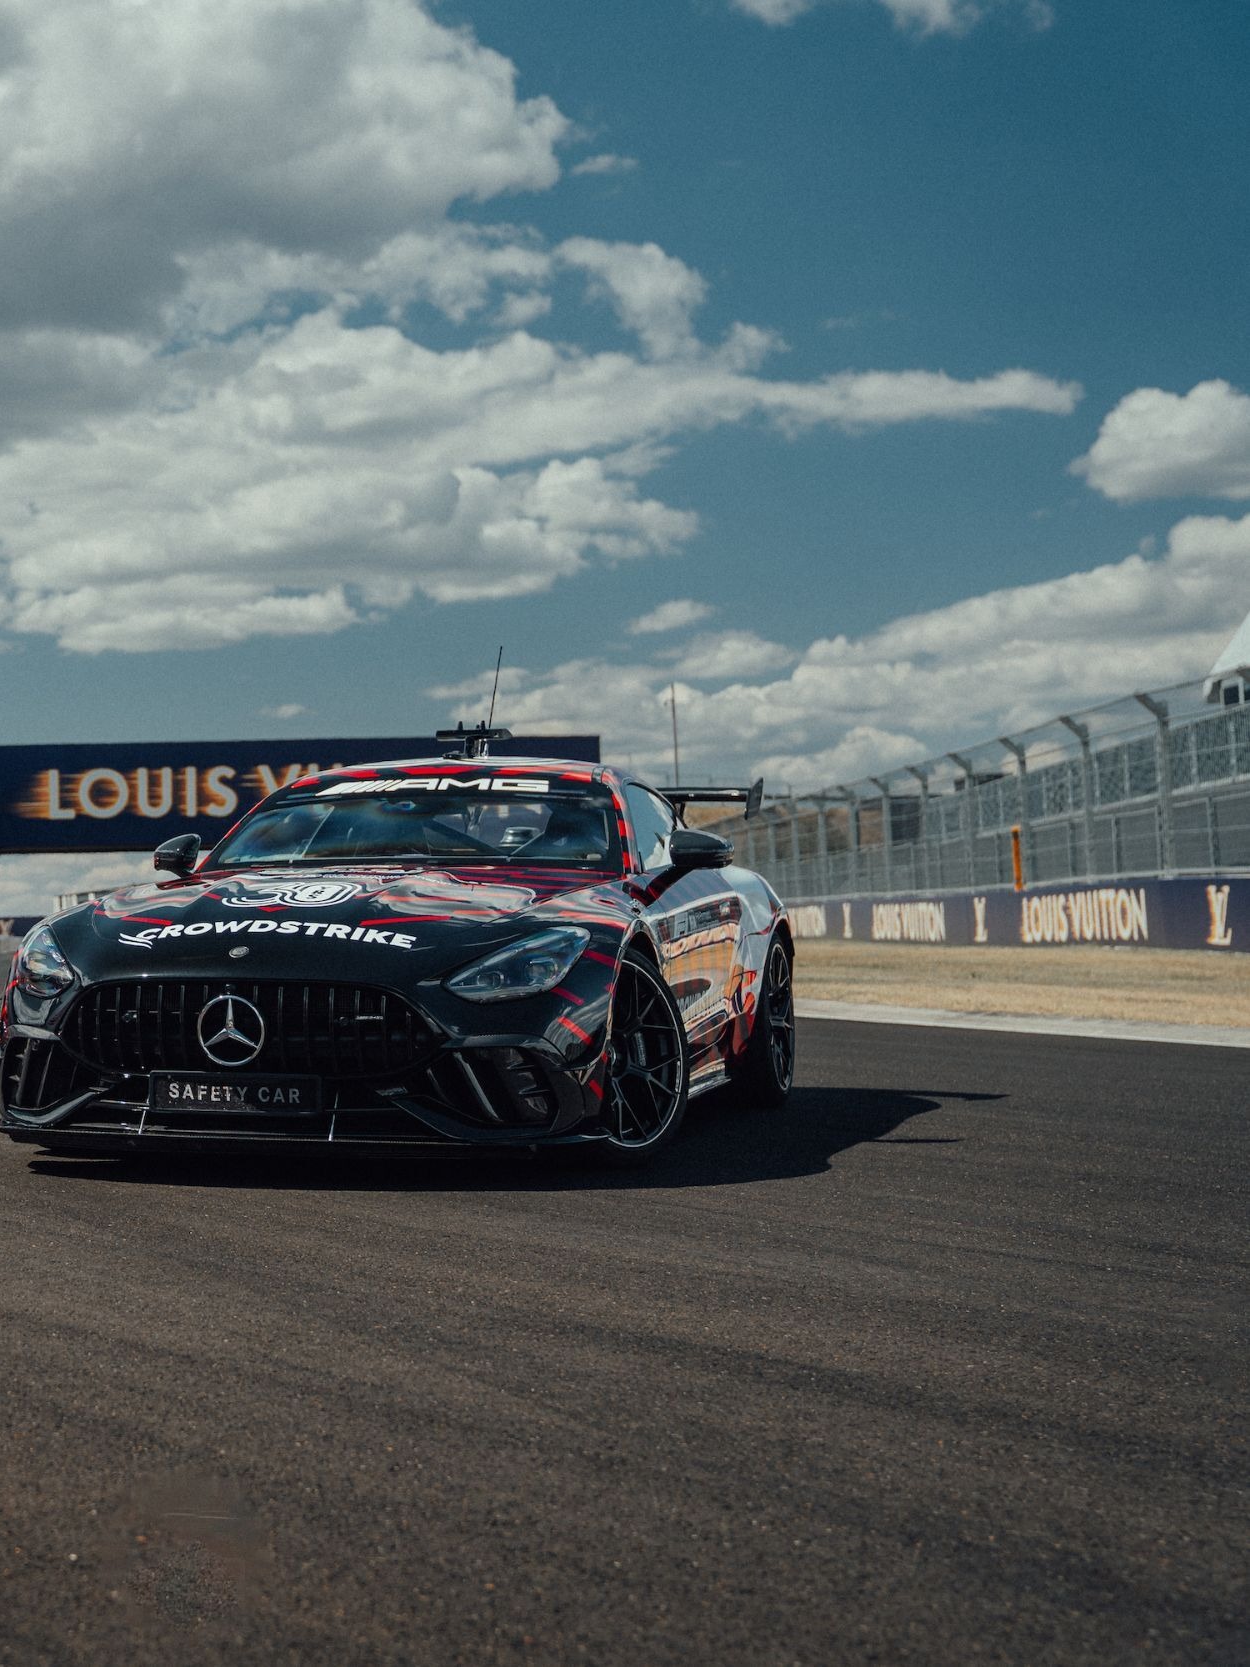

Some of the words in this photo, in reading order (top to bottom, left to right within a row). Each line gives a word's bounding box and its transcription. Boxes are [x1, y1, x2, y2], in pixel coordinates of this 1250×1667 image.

[46, 766, 239, 820] LOUIS
[392, 778, 549, 793] AMG
[1021, 893, 1068, 943] LOUIS
[1068, 888, 1149, 941] VUITTON
[136, 919, 418, 949] CROWDSTRIKE
[168, 1082, 248, 1102] SAFETY
[258, 1086, 300, 1104] CAR
